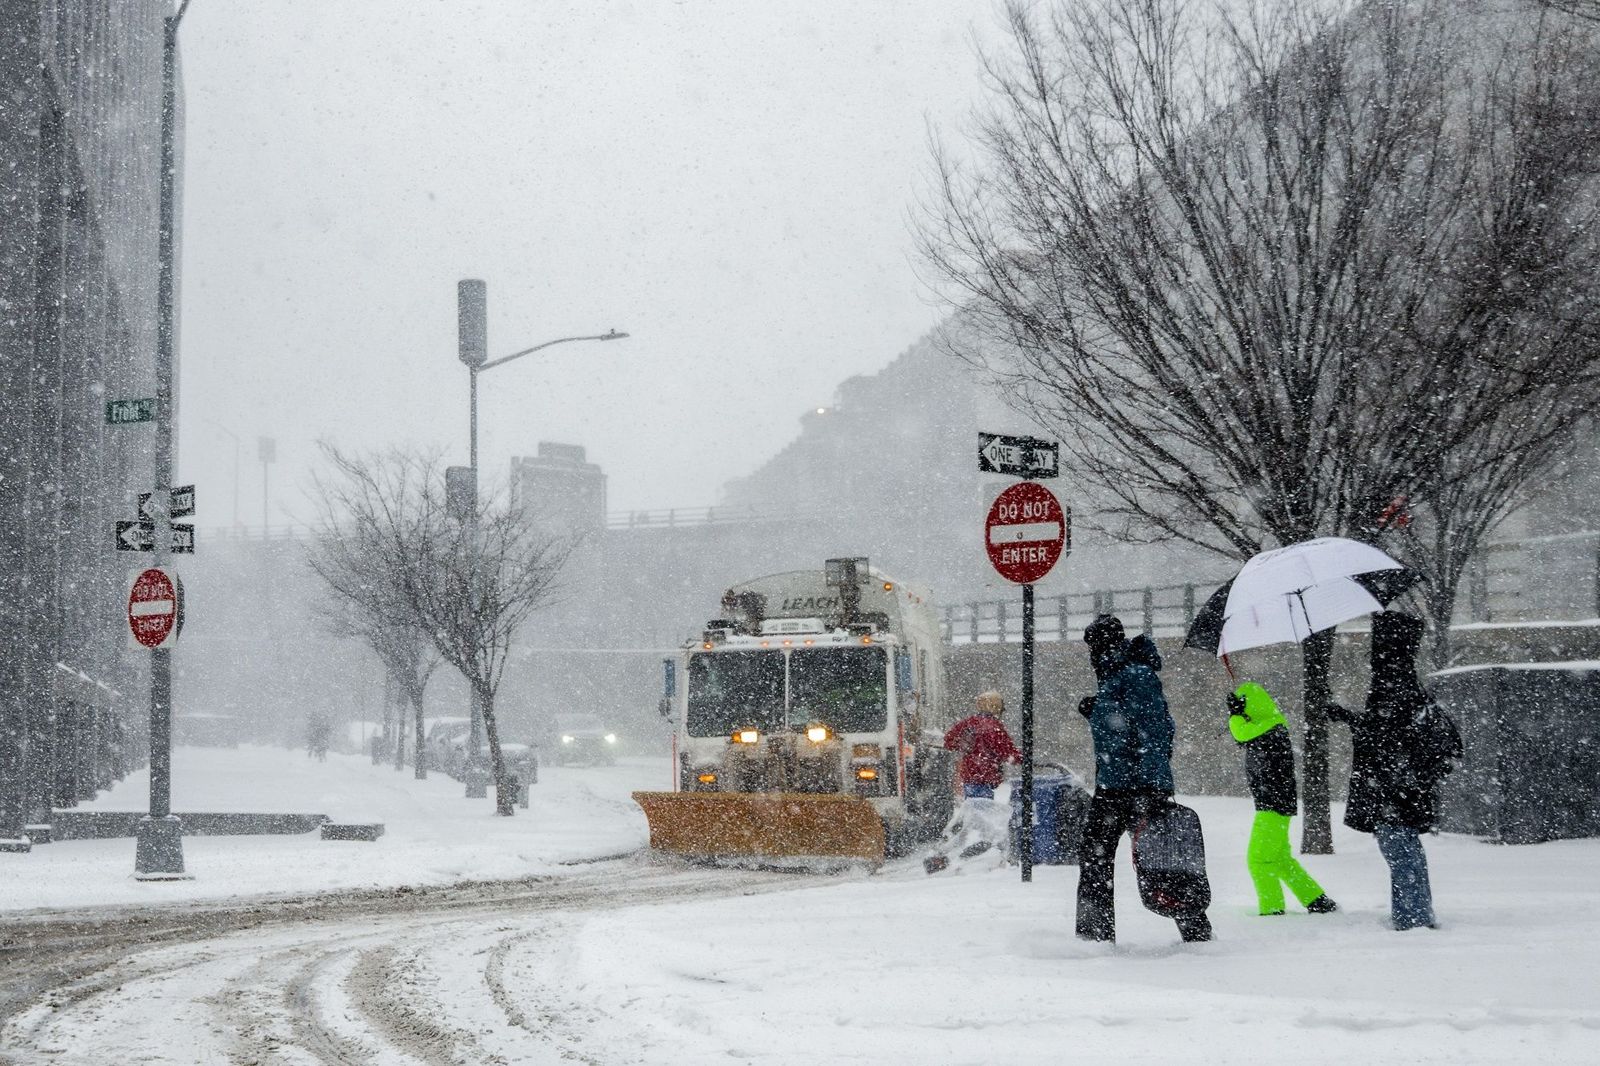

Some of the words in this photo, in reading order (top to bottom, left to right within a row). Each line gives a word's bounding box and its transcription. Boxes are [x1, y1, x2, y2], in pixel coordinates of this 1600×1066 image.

[990, 446, 1013, 463] ONE
[999, 503, 1018, 519] DO
[1023, 501, 1050, 518] NOT
[1000, 548, 1047, 564] ENTER
[782, 597, 841, 610] LEACH
